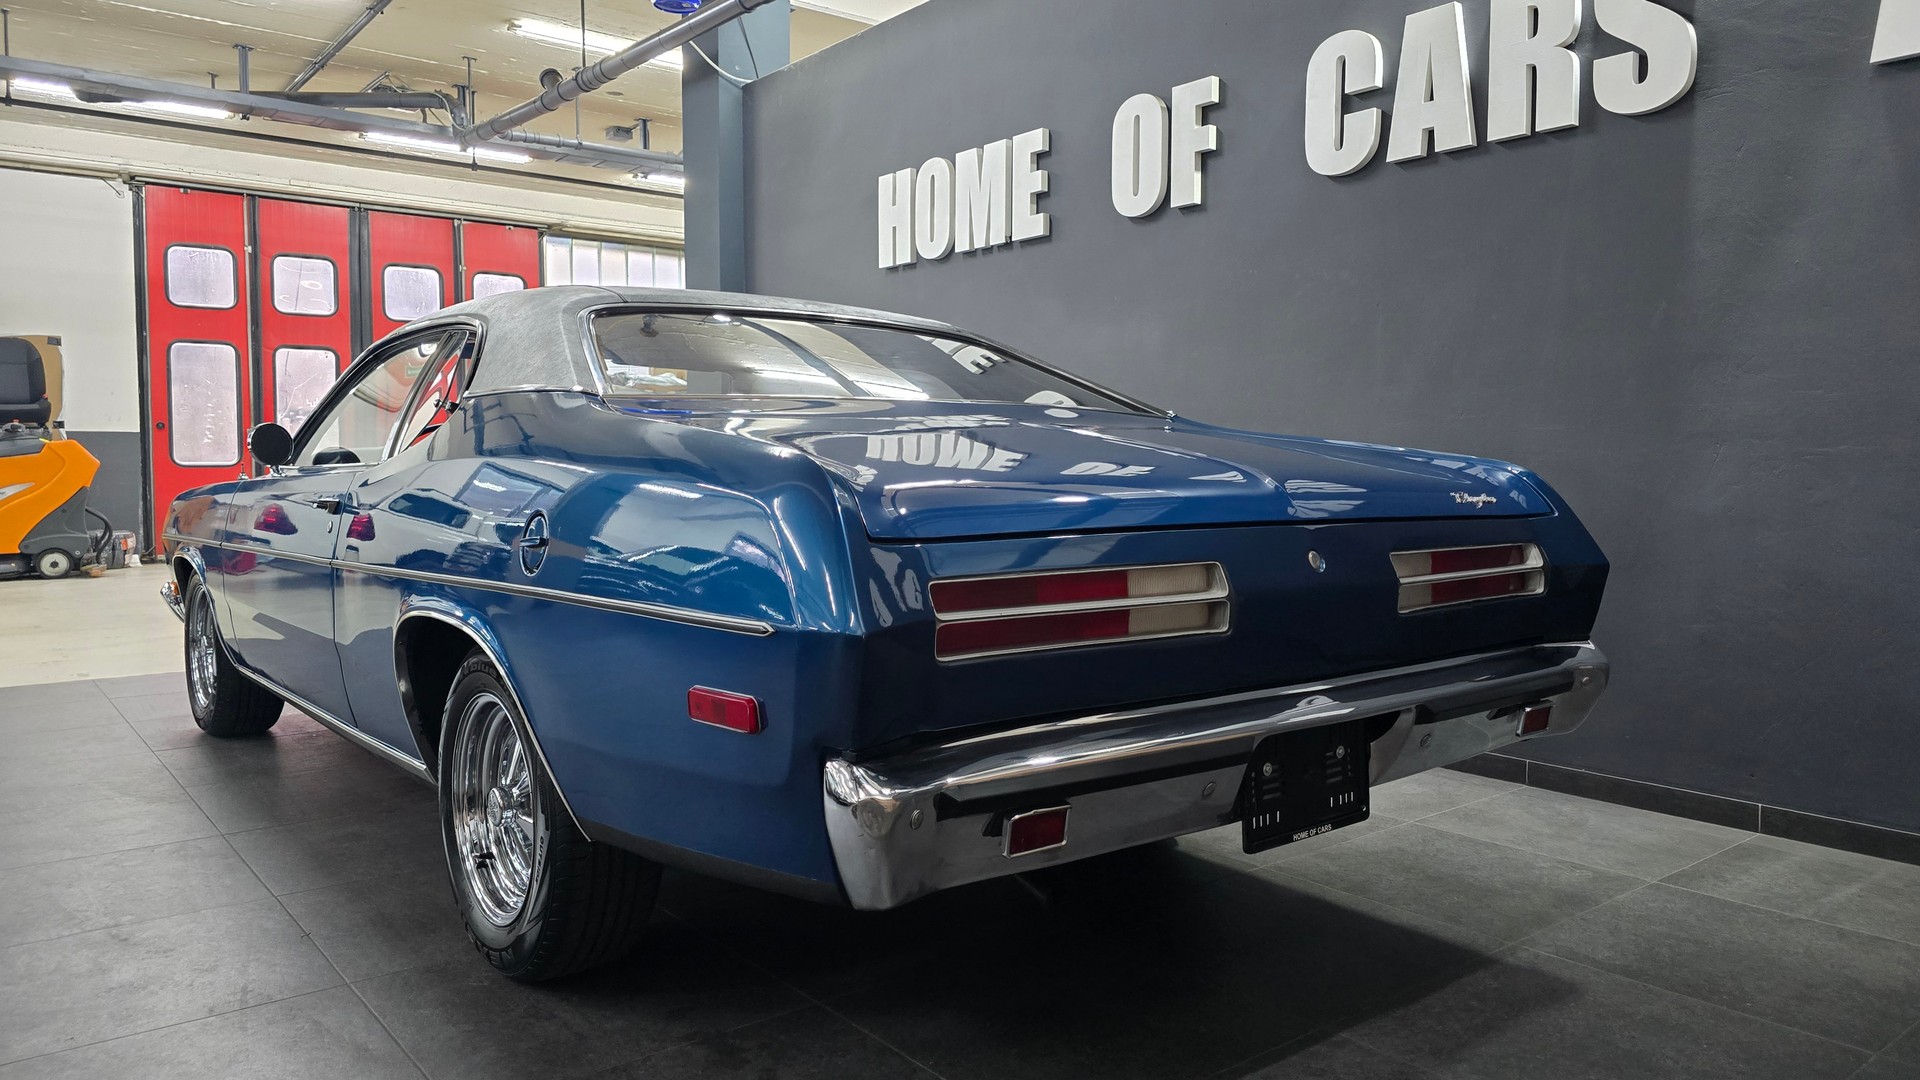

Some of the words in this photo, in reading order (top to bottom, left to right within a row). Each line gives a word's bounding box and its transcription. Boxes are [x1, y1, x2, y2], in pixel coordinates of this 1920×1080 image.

[879, 128, 1050, 268] HOME
[1112, 76, 1219, 218] OF
[1305, 0, 1698, 177] CARS
[1292, 830, 1309, 841] HOME
[1309, 828, 1317, 836] OF
[1317, 824, 1332, 834] CARS
